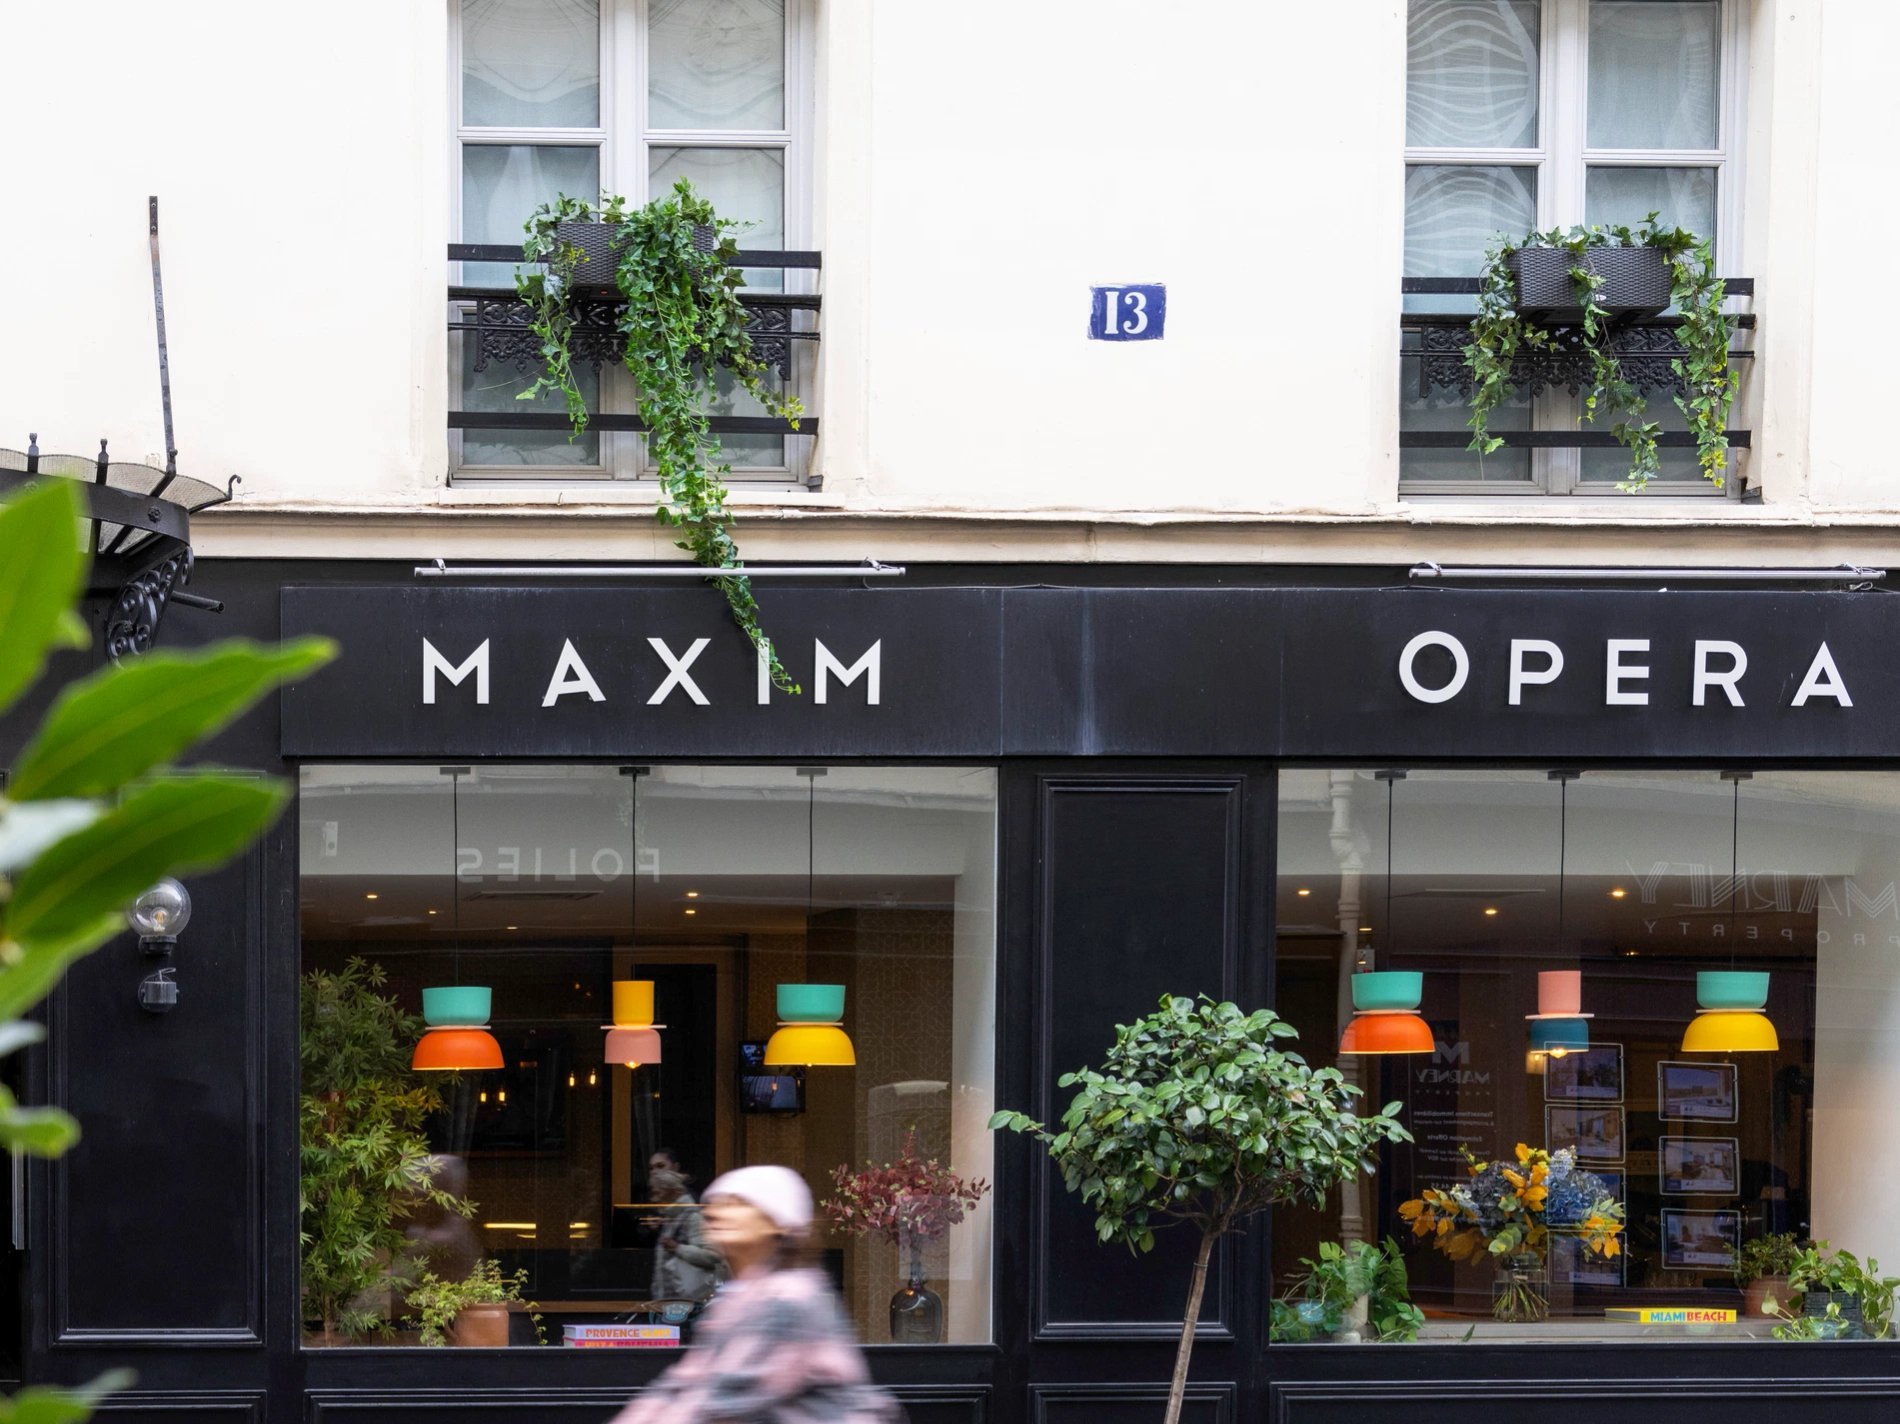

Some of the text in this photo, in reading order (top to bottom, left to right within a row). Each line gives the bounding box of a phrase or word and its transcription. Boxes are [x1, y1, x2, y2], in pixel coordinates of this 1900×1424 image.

[1104, 291, 1148, 335] 13
[422, 636, 882, 708] MAXIM
[1398, 630, 1854, 708] OPERA
[585, 1328, 640, 1338] PROVENCE
